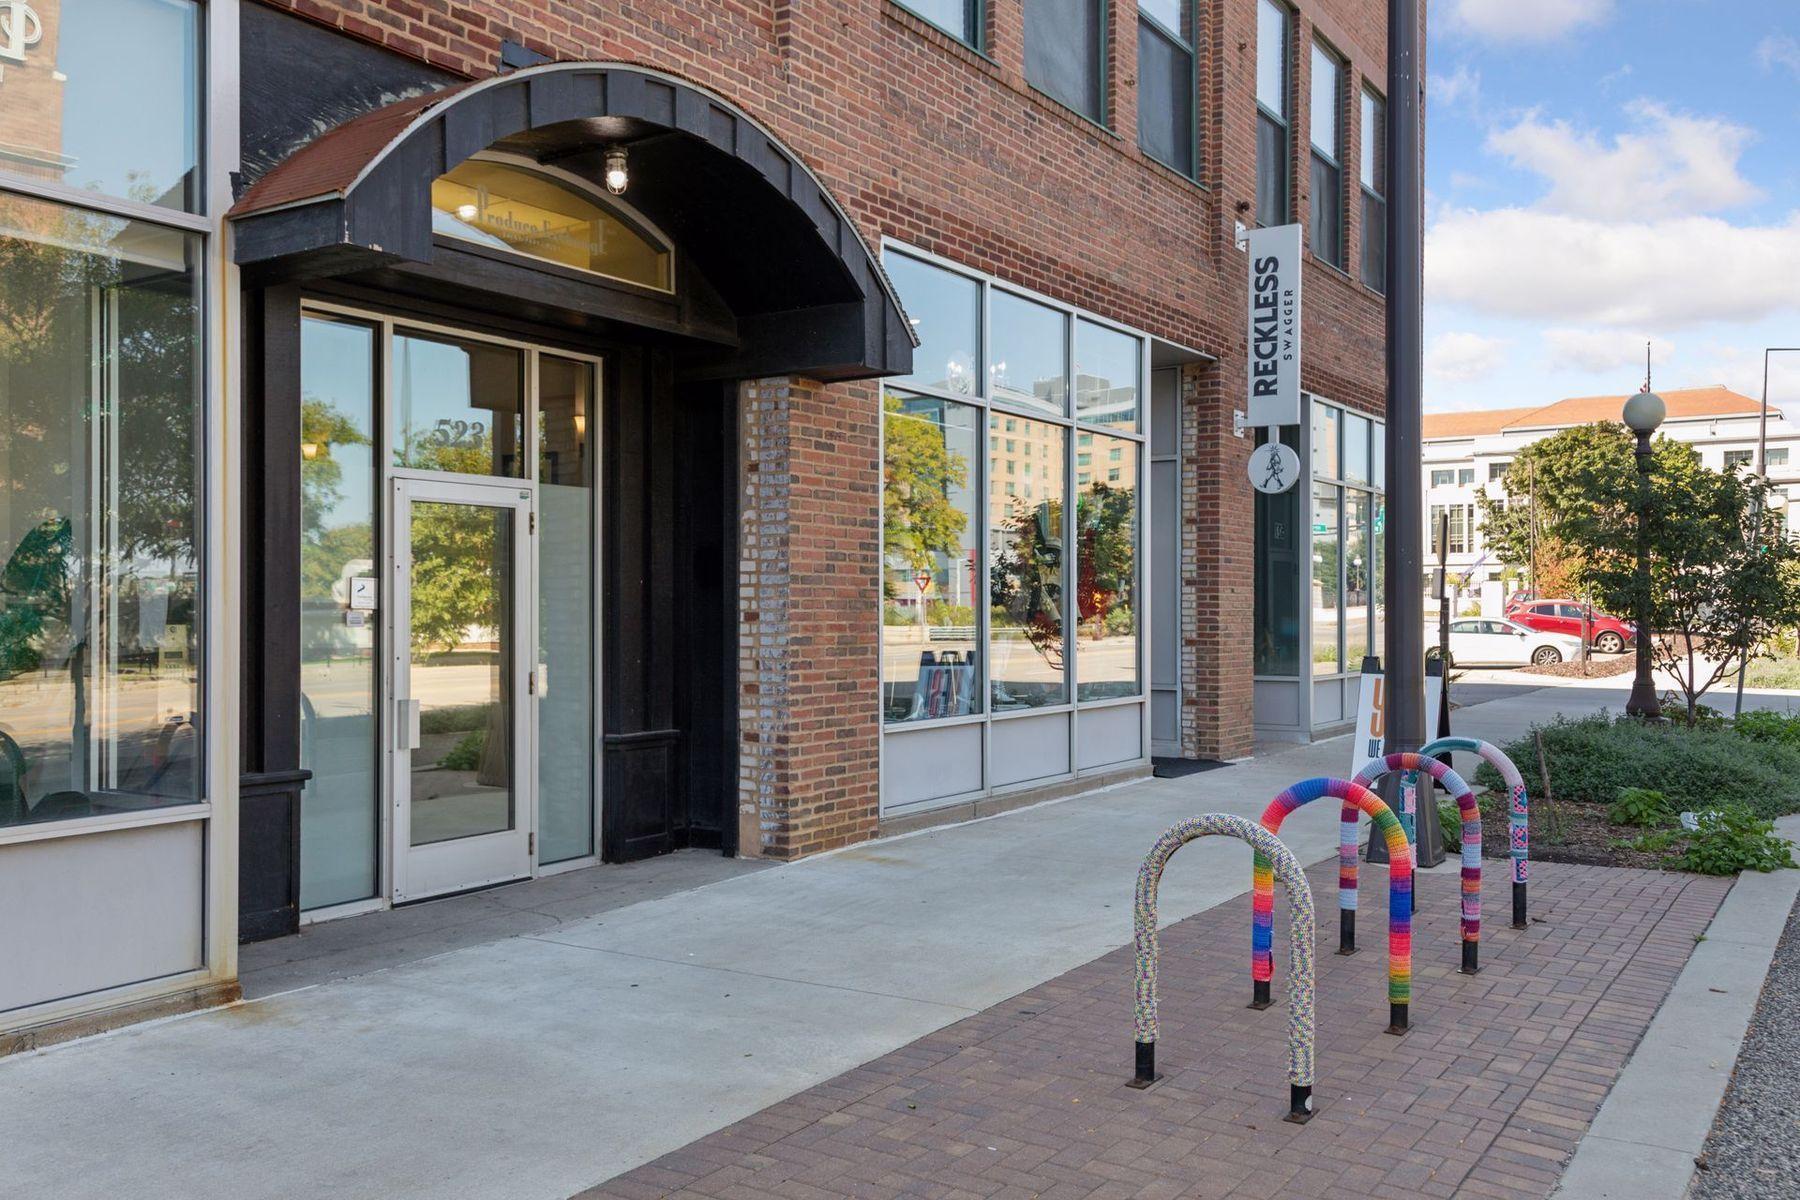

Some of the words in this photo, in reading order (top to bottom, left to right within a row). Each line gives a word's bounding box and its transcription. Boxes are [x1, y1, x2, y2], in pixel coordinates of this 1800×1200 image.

[1253, 256, 1279, 396] RECKLESS
[1284, 289, 1293, 360] SWAGGER
[432, 418, 485, 448] 523
[1368, 739, 1381, 758] WE
